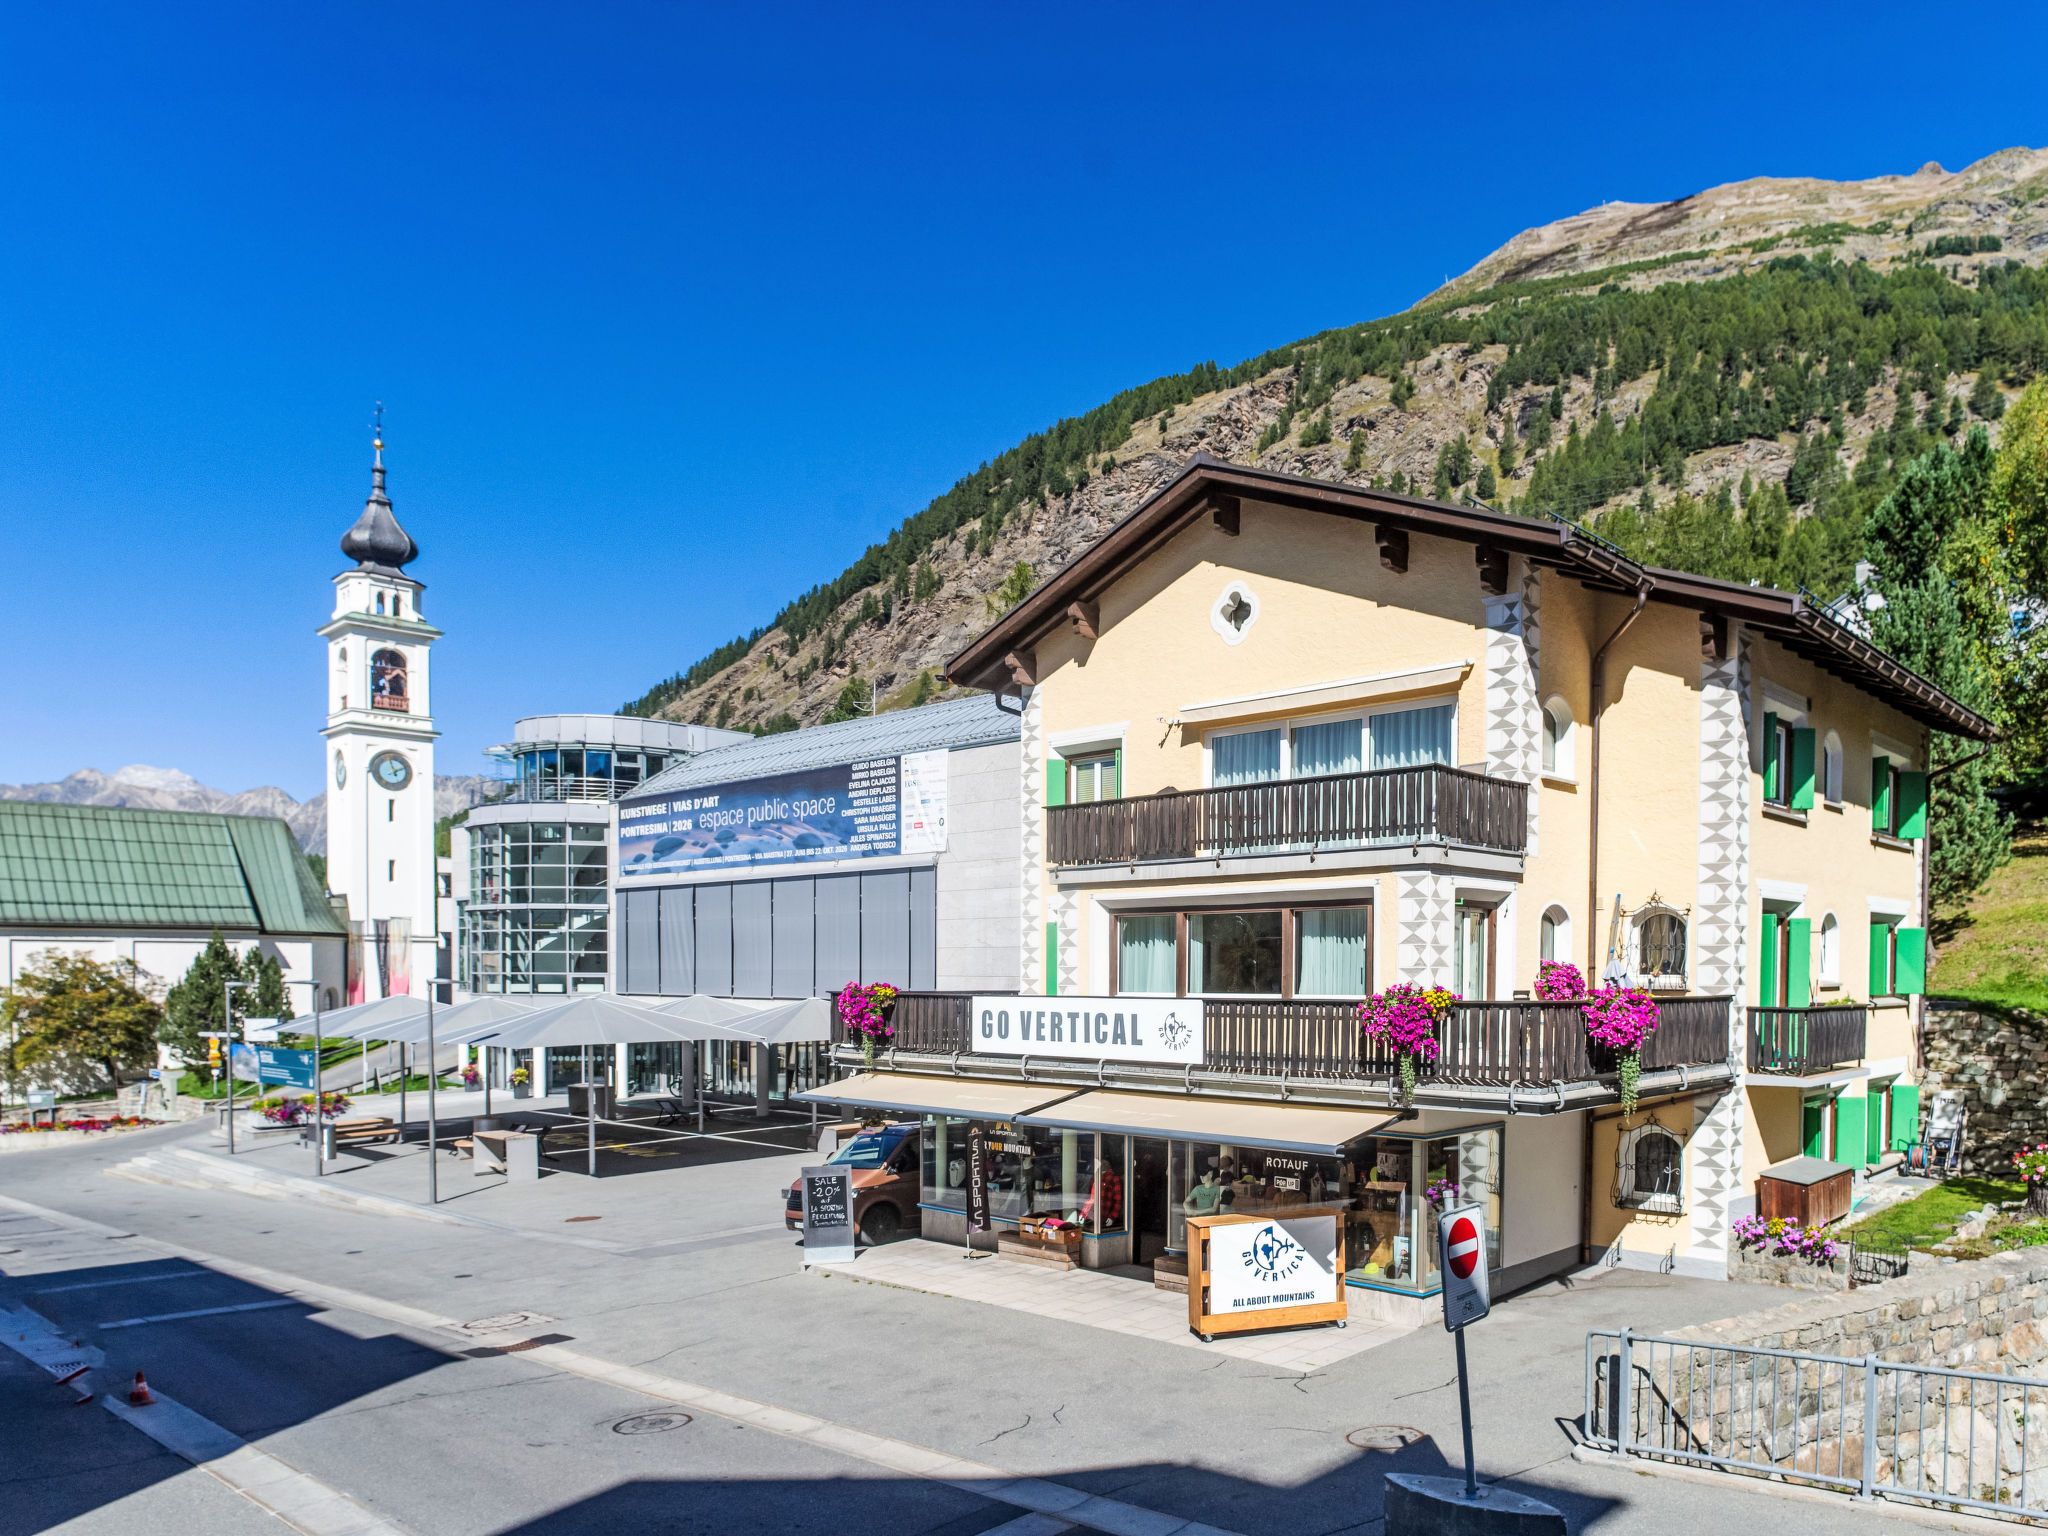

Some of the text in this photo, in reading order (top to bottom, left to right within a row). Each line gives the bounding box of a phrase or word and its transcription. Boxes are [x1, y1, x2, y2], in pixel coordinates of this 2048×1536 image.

[852, 758, 896, 771] GUIDO BASELGIA
[852, 767, 896, 780] MIRKO BASELGIA
[848, 780, 870, 789] EVELINA
[871, 776, 896, 786] CAJACOB
[869, 785, 896, 796] DEPLAZES
[879, 795, 896, 804] LABES
[620, 796, 720, 820] KUNSTWEGE VIAS D'ART
[699, 797, 836, 832] espace public space
[841, 804, 896, 817] CHRISTOPH DRAEGER
[869, 813, 896, 822] MASÜGER
[620, 819, 693, 838] PONTRESINA 2026
[857, 823, 896, 833] URSULA PALLA
[850, 832, 896, 843] JULES SPINATSCH
[850, 841, 896, 851] ANDREA TODISCO
[981, 1010, 1144, 1047] GO VERTICAL
[988, 1141, 1003, 1152] YOUR
[1003, 1143, 1031, 1156] MOUNTAIN
[1266, 1156, 1309, 1171] ROTAUF
[971, 1138, 983, 1207] SPORTIVA
[814, 1176, 837, 1185] SALE
[812, 1186, 841, 1197] -20%
[1241, 1247, 1306, 1281] GO VERTICAL
[1232, 1290, 1315, 1307] ALL ABOUT MOUNTAINS
